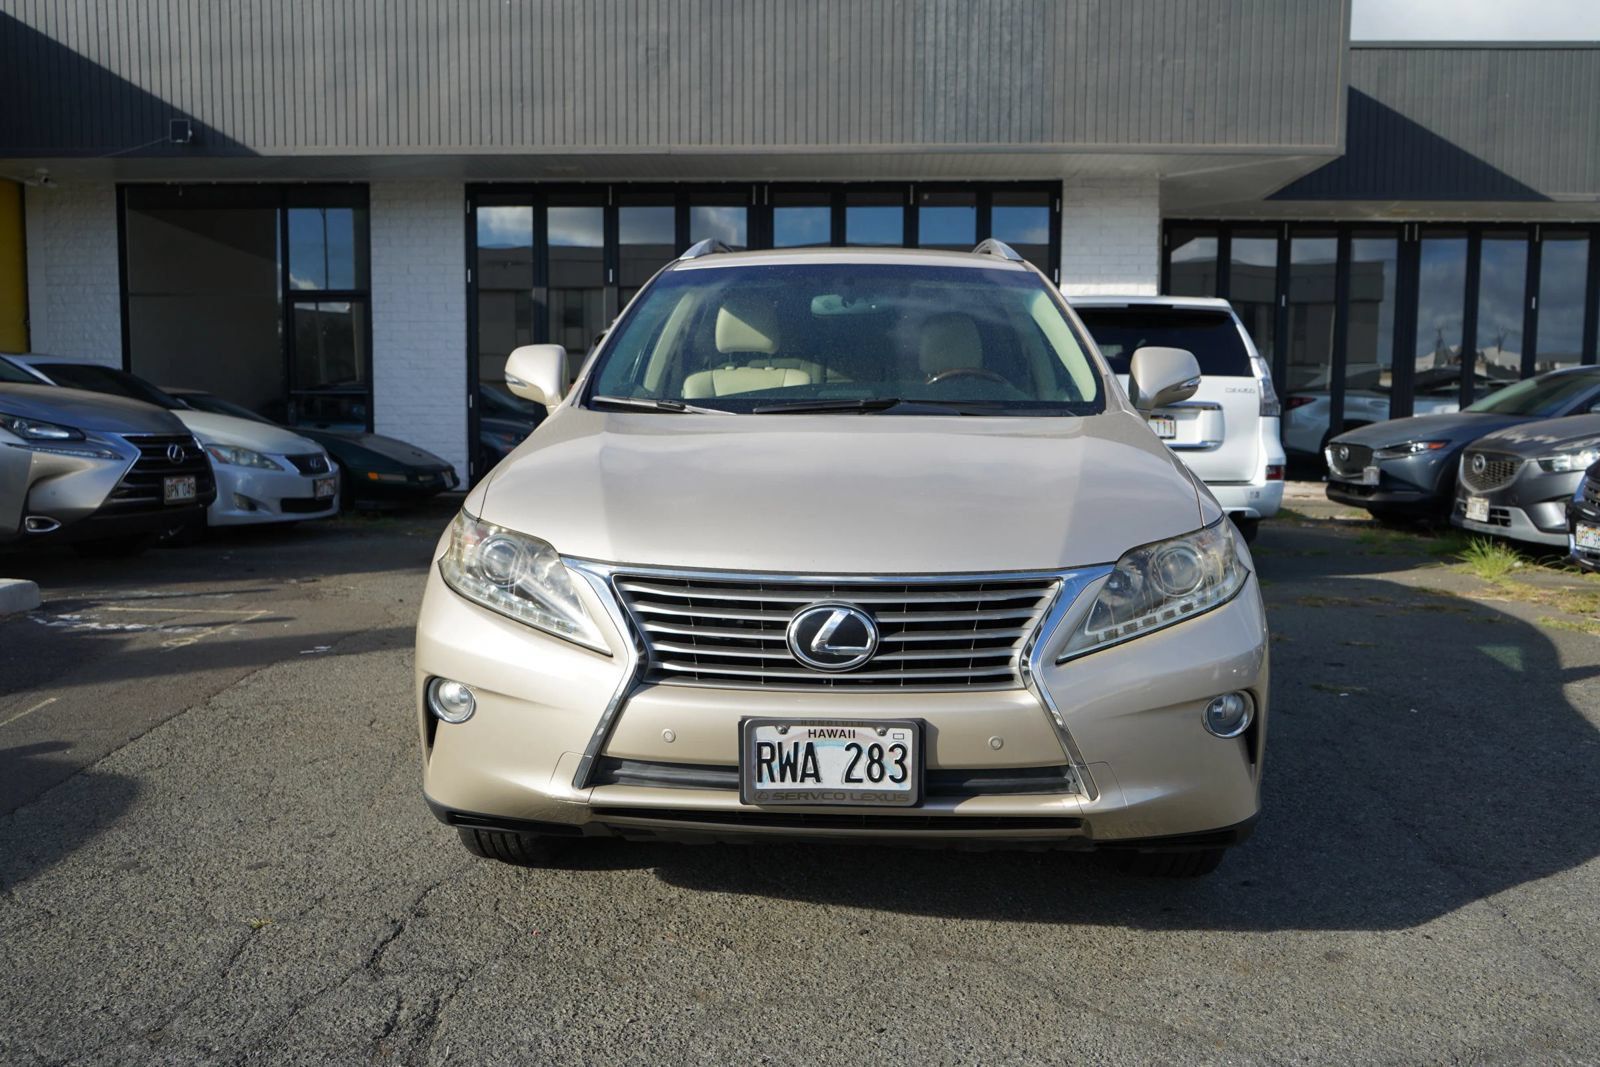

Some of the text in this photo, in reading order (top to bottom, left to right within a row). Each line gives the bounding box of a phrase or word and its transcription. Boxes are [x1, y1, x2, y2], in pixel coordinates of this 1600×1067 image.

[808, 729, 856, 739] HAWAII
[757, 742, 907, 783] RWA 283
[772, 792, 909, 801] SERVCO LEXUS
